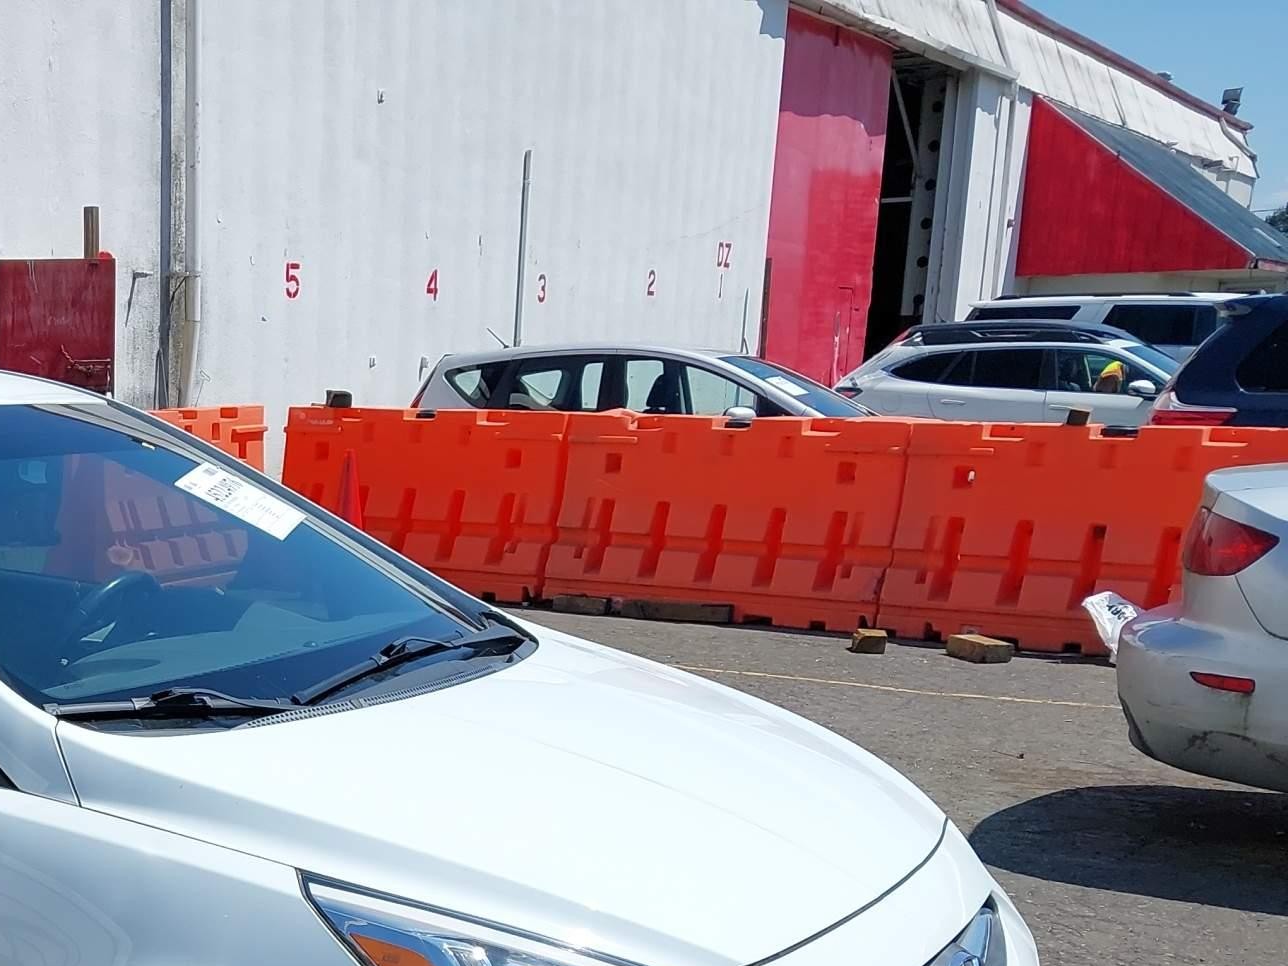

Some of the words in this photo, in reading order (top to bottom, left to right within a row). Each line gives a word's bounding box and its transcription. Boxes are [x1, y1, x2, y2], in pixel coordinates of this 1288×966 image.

[716, 241, 732, 269] DZ
[285, 262, 301, 299] 5
[426, 269, 439, 301] 4
[536, 273, 547, 303] 3
[646, 269, 657, 297] 2
